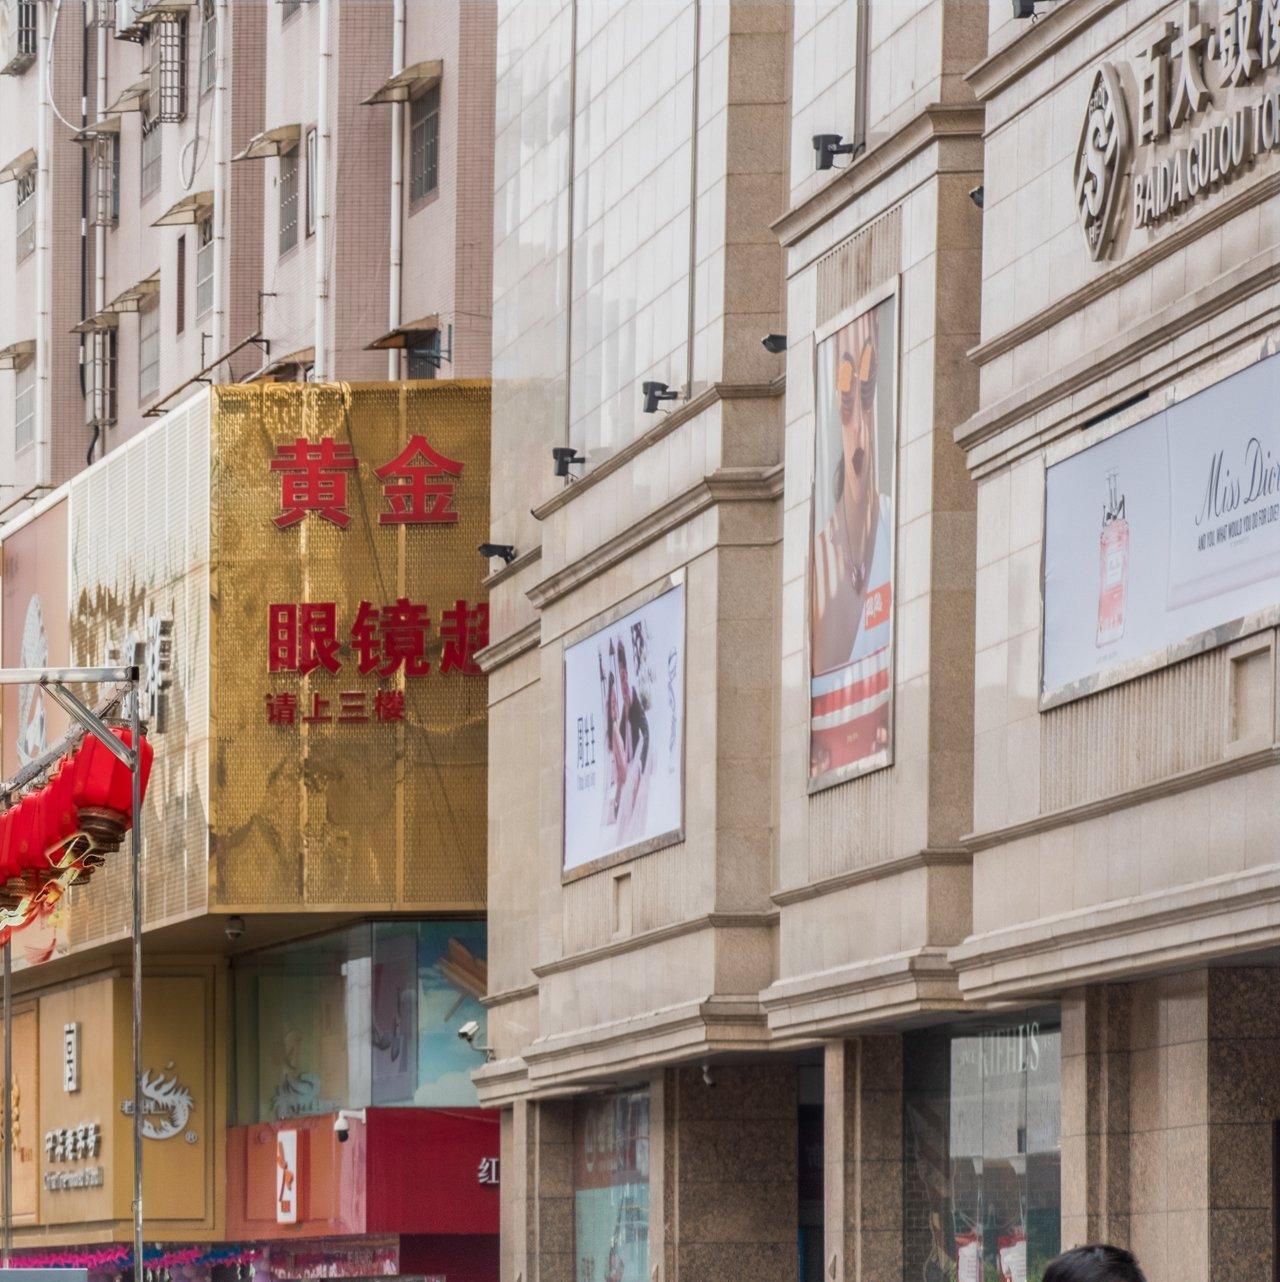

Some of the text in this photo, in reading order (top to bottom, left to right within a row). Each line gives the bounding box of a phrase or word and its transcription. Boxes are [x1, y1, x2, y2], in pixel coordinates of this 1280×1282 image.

[1134, 150, 1187, 229] BAIDA
[1187, 110, 1246, 197] GULOU
[270, 434, 466, 530] 黄金
[1195, 449, 1241, 526] Miss
[1216, 524, 1228, 544] WHAT
[1228, 518, 1243, 538] WOULD
[1243, 514, 1252, 533] YOU
[266, 690, 407, 726] 请上三楼
